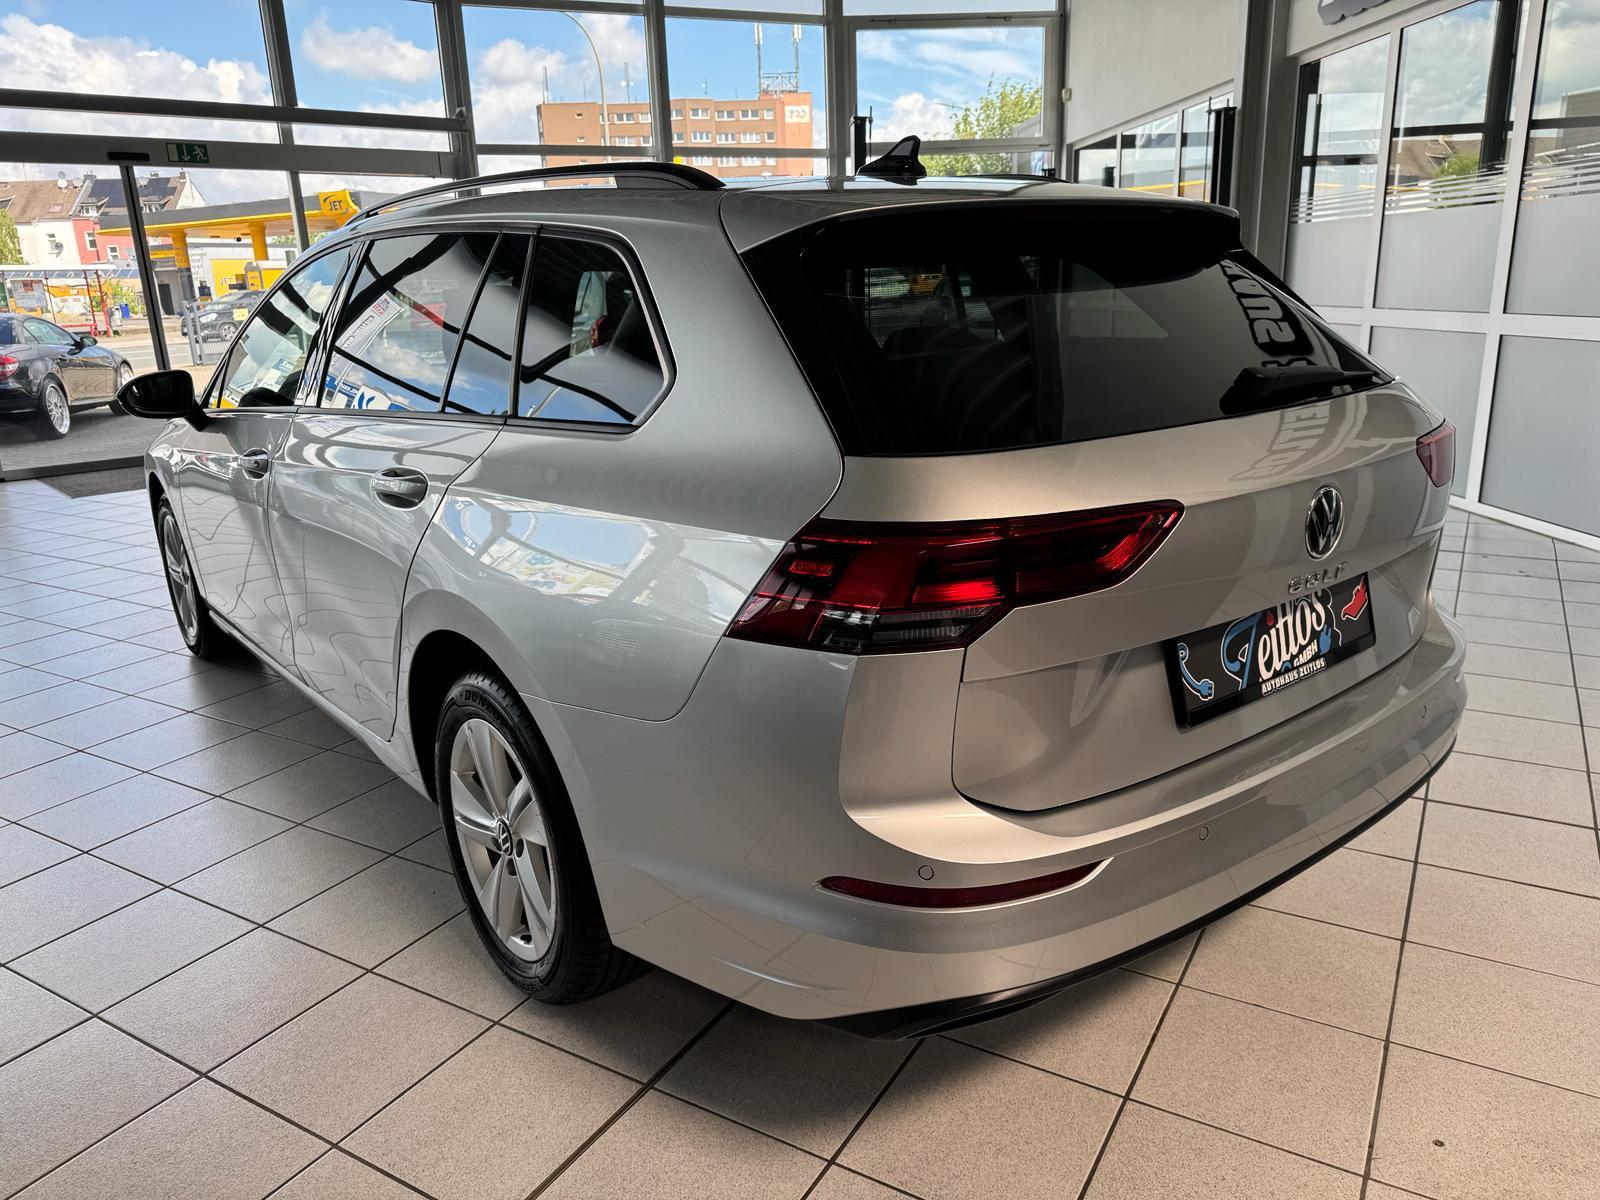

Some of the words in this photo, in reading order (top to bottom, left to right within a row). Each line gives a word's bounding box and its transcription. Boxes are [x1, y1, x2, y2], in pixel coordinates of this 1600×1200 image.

[328, 199, 344, 212] JET
[1288, 561, 1348, 594] GOLF
[1261, 670, 1299, 695] AUTOHAUS
[1299, 657, 1326, 677] ZEITLOS
